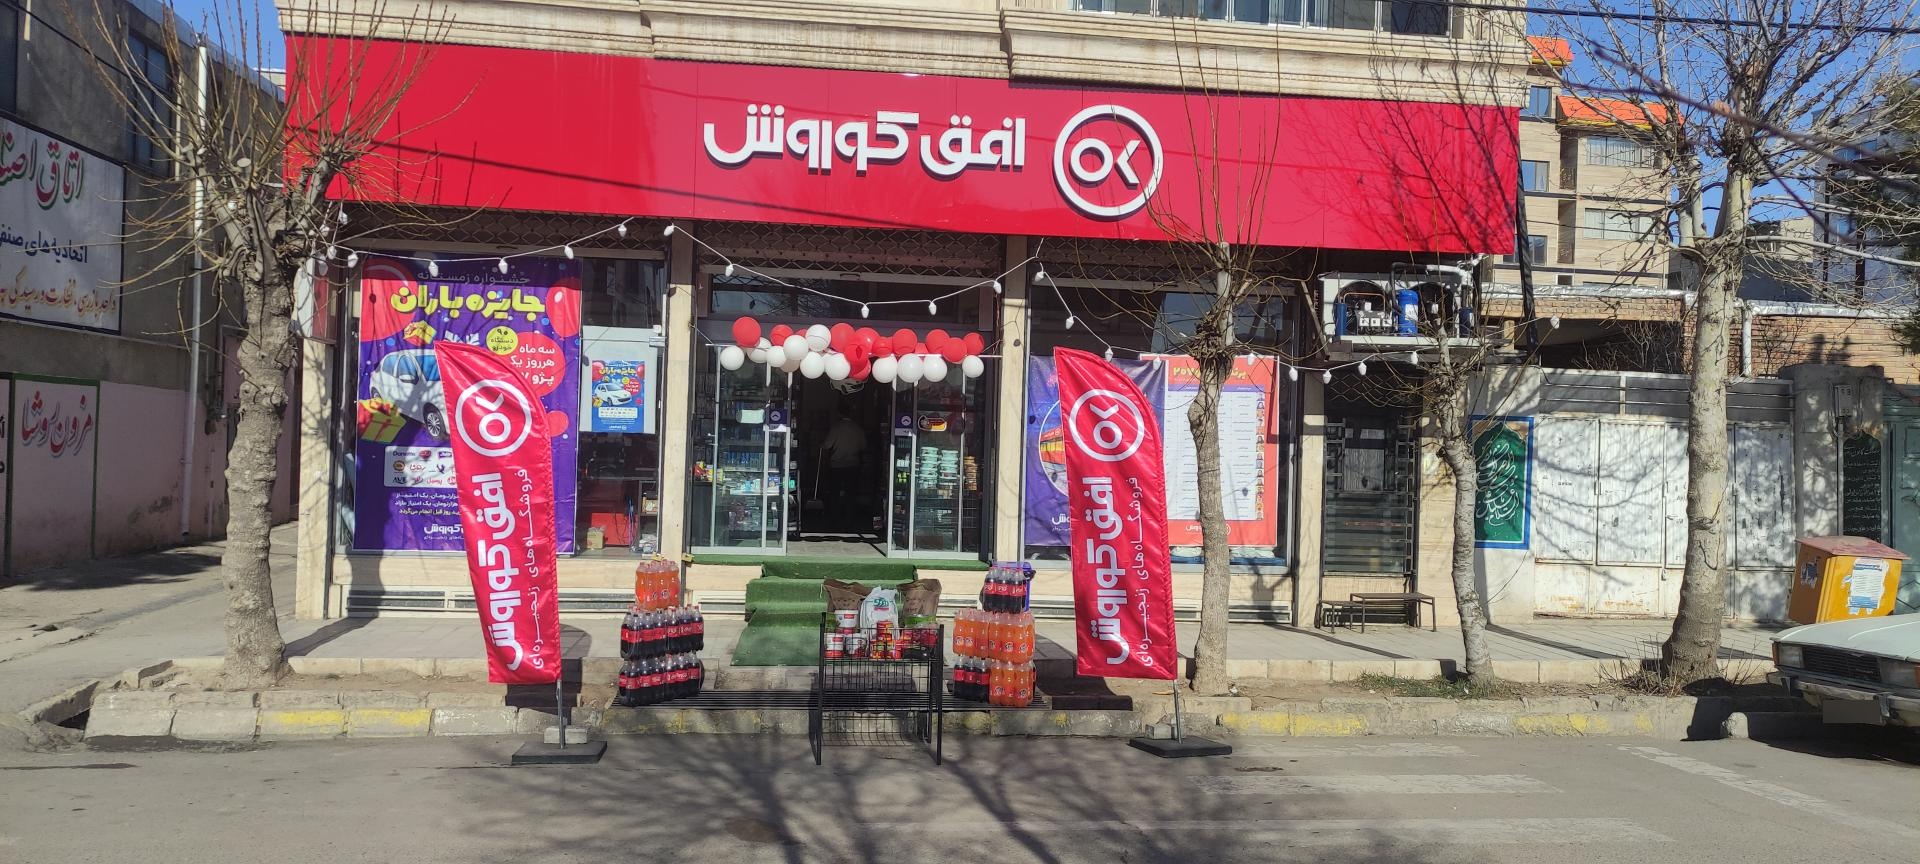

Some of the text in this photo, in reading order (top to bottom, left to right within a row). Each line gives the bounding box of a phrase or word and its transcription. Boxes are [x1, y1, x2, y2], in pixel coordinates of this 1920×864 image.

[703, 103, 1027, 180] افق کوروش
[36, 141, 84, 211] اتاق
[0, 223, 24, 247] صنف
[390, 284, 546, 321] جایزه باران
[519, 343, 555, 354] سه ماه
[531, 371, 555, 387] پژو
[472, 472, 524, 671] افق کوروش
[1081, 475, 1130, 666] افق کوروش
